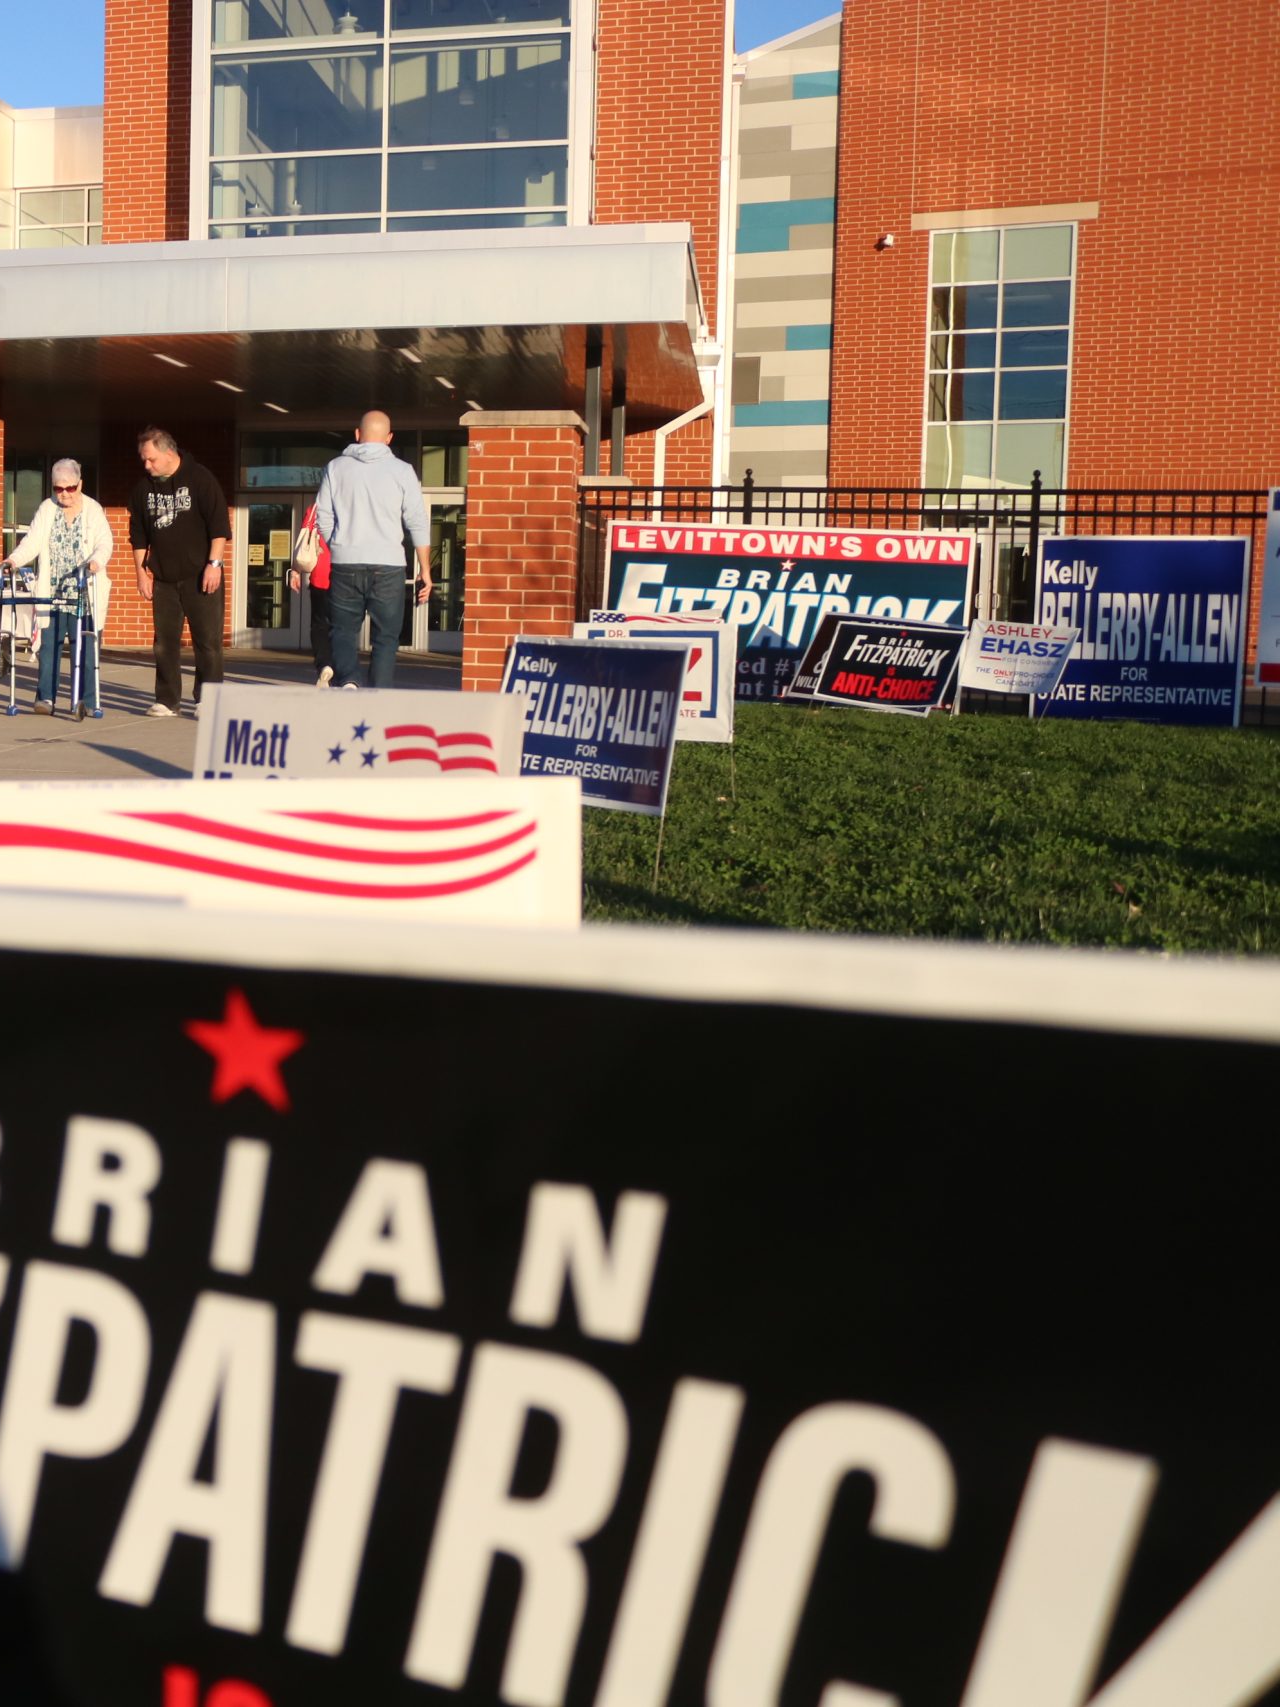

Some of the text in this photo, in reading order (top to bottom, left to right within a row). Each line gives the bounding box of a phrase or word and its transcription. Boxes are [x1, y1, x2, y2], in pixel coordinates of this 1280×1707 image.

[617, 529, 963, 561] LEVITTOWN'S OWN
[716, 568, 852, 593] BRIAN
[1043, 560, 1098, 590] Kelly
[608, 629, 626, 638] DR.
[984, 624, 1053, 638] ASHLEY
[879, 637, 923, 648] BRIAN
[980, 637, 1066, 658] EHASZ
[843, 635, 949, 676] FITZPATRICK
[517, 656, 557, 678] Kelly
[993, 668, 1013, 676] ONLY
[1120, 667, 1148, 681] FOR
[831, 671, 937, 700] ANTI-CHOICE
[1090, 685, 1232, 706] REPRESENTATIVE
[512, 679, 675, 747] ELLERBY-ALLEN
[224, 719, 289, 768] Matt
[575, 744, 598, 758] FOR
[543, 757, 660, 787] REPRESENTATIVE
